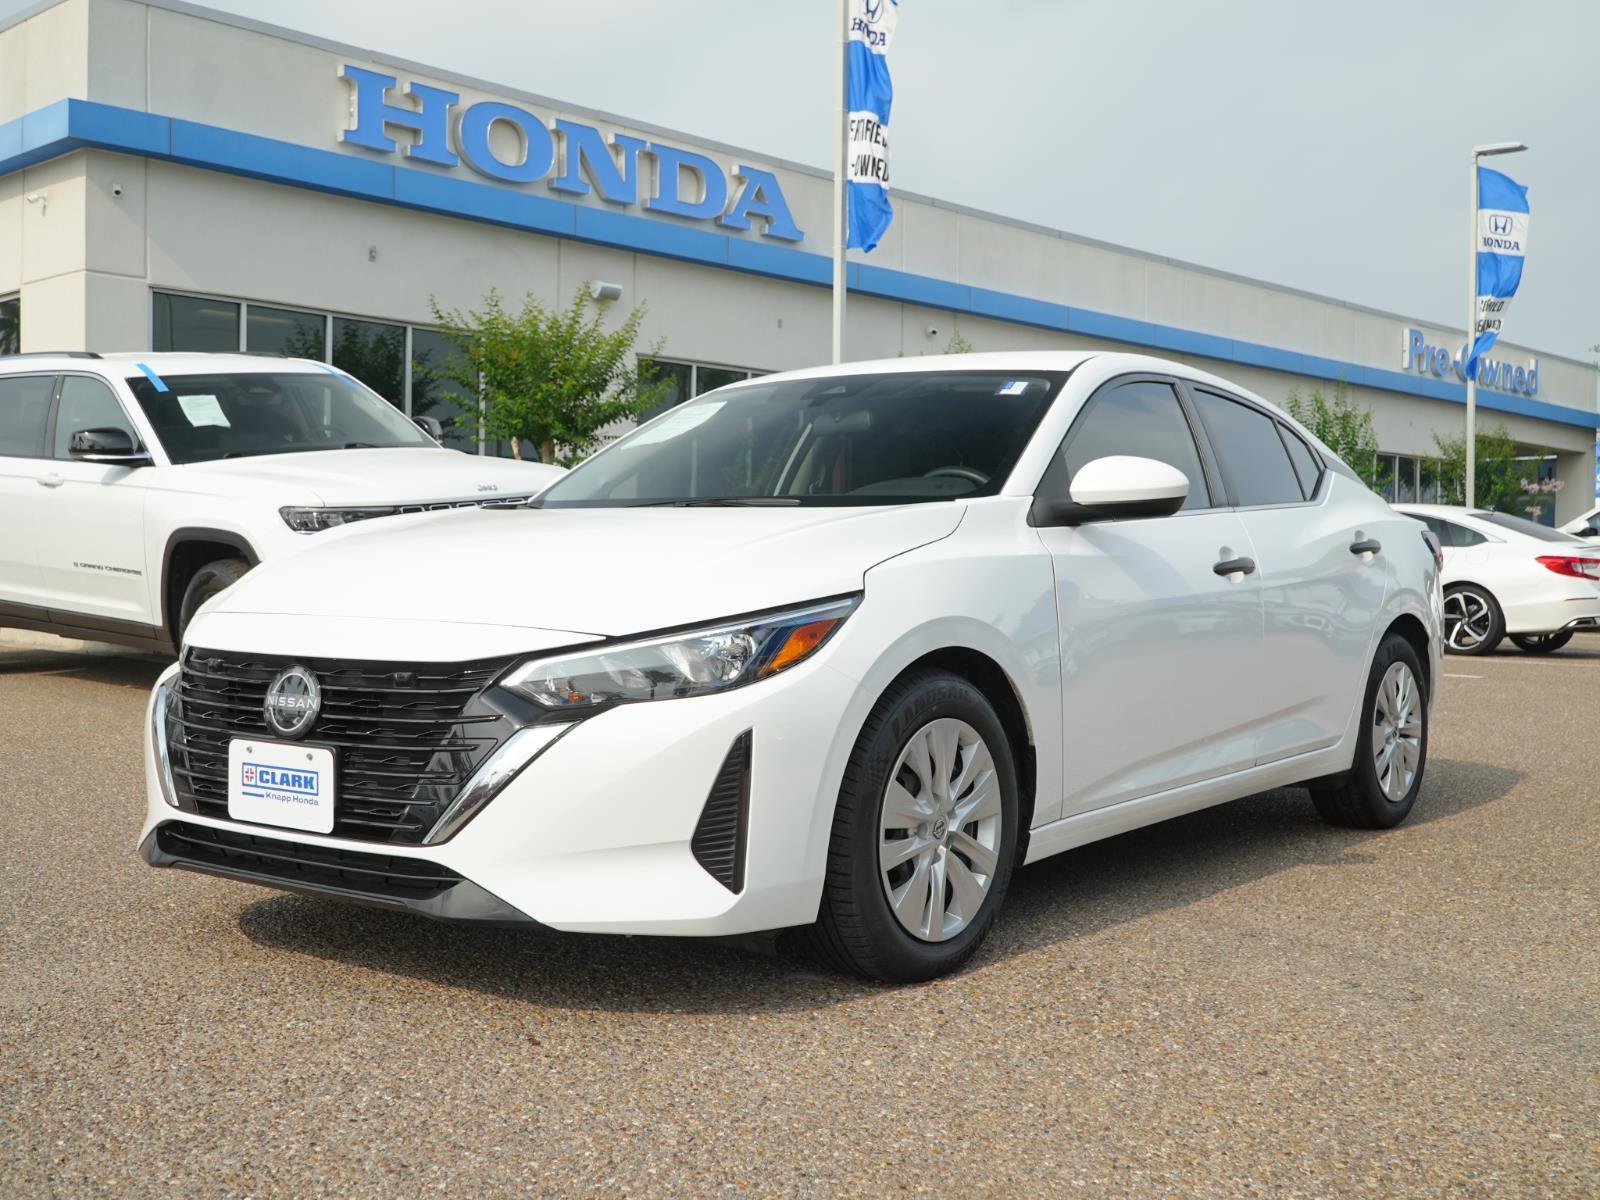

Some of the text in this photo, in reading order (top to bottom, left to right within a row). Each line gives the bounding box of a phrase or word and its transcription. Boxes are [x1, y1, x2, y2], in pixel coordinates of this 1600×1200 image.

[337, 64, 804, 242] HONDA
[267, 694, 318, 709] NISSAN
[258, 769, 315, 791] CLARK
[265, 791, 319, 807] Knapp Honda
